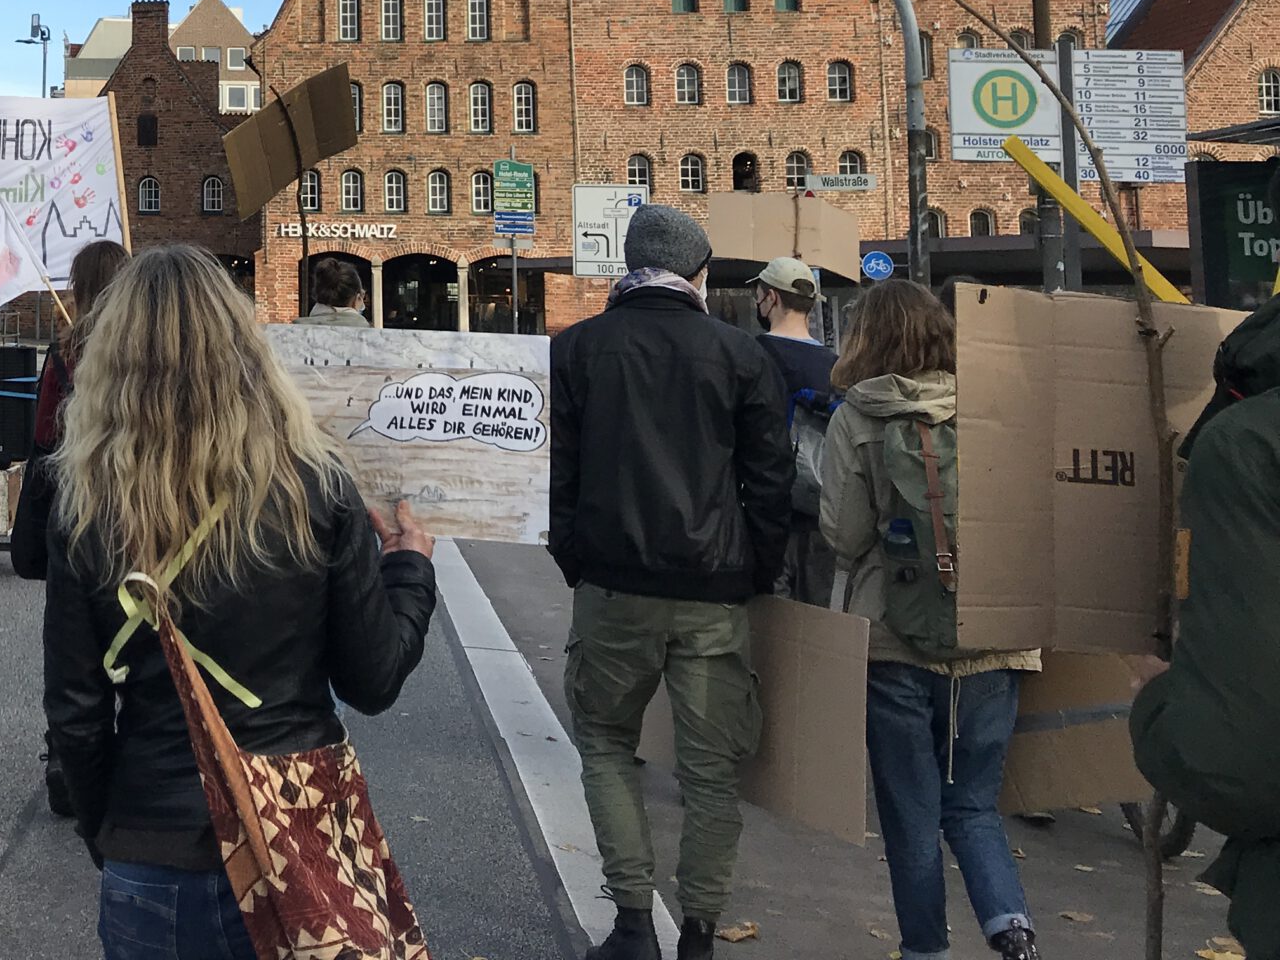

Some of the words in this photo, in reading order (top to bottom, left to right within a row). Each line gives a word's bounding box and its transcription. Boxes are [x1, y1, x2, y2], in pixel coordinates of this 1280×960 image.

[1136, 51, 1144, 61] 2
[1083, 64, 1090, 73] 5
[1137, 65, 1144, 74] 6
[1084, 77, 1091, 86] 7
[1138, 78, 1145, 87] 9
[991, 82, 1018, 115] H
[1078, 90, 1091, 99] 10
[1134, 92, 1146, 100] 11
[1078, 103, 1092, 112] 15
[1134, 105, 1147, 114] 16
[1080, 117, 1093, 126] 17
[1133, 118, 1147, 127] 21
[1133, 131, 1148, 140] 32
[1155, 144, 1186, 154] 6000
[1134, 157, 1149, 167] 12
[1081, 169, 1095, 179] 30
[1135, 170, 1150, 180] 40
[821, 176, 869, 187] Wallstraße
[597, 264, 614, 274] 100
[459, 385, 493, 401] MEIN
[411, 401, 447, 415] WIRD
[462, 403, 528, 421] EINMAL
[387, 416, 437, 431] ALLES
[443, 420, 466, 435] DIR
[472, 421, 541, 443] GEHÖREN!
